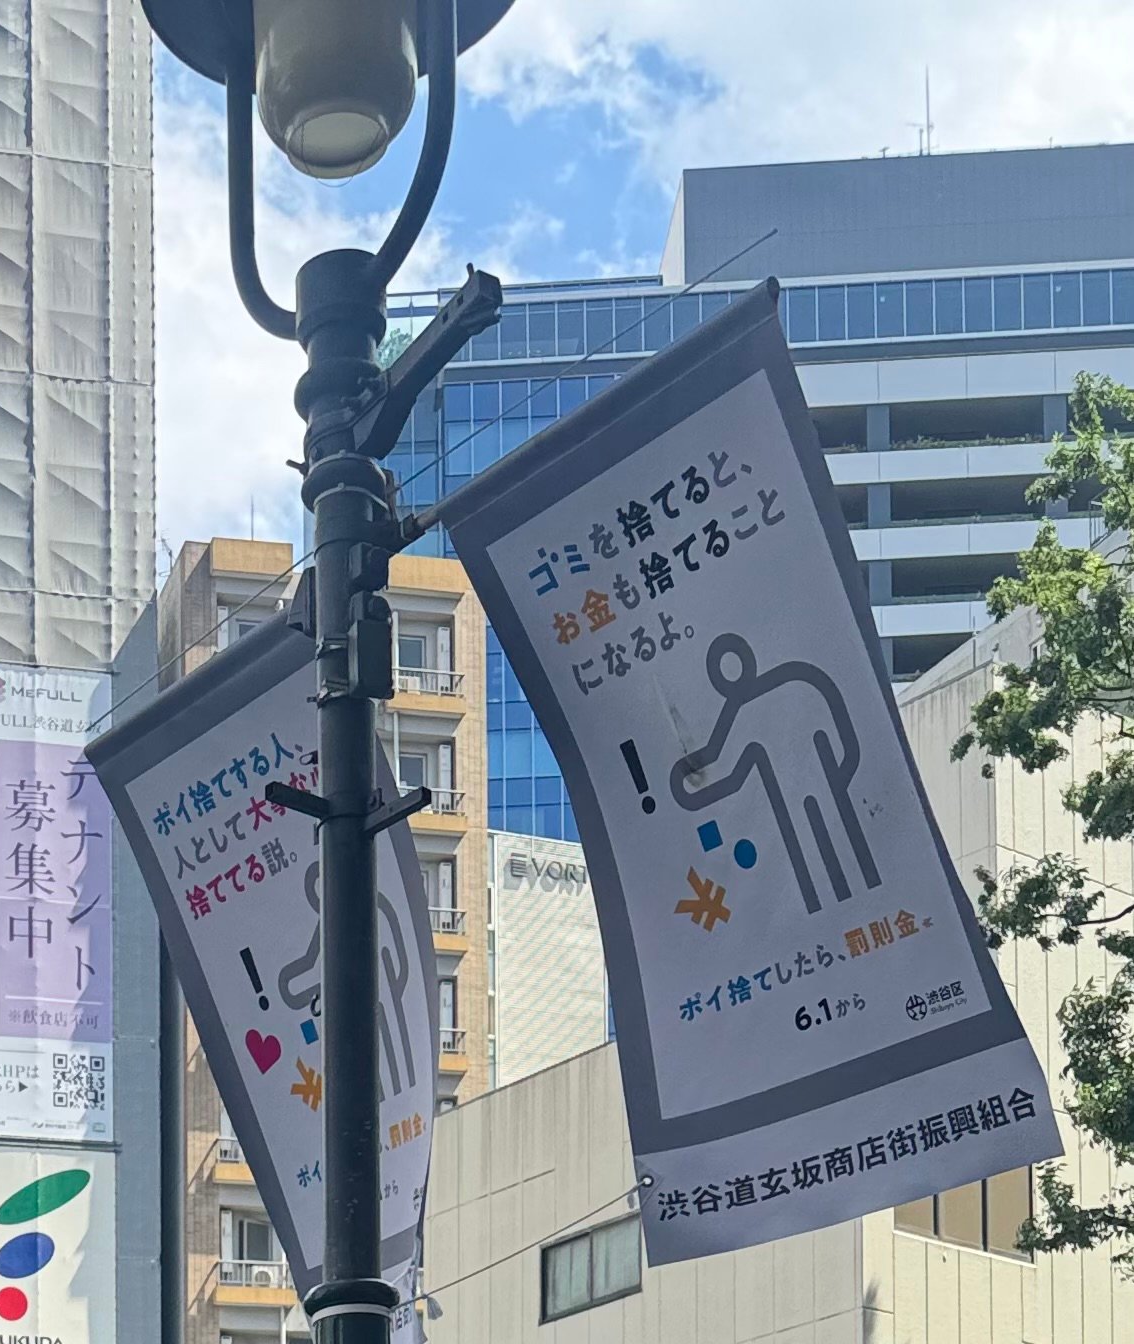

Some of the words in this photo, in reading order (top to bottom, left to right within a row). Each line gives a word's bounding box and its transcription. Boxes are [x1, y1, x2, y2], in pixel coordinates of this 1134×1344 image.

[529, 450, 753, 596] ゴミを捨てると、
[552, 488, 786, 646] お金も捨てること
[571, 612, 696, 697] になるよ。
[153, 732, 303, 836] ポイ捨てする人、
[4, 779, 56, 959] 募集中
[60, 759, 103, 991] テナント
[185, 837, 298, 921] 捨ててる説。
[794, 992, 866, 1031] 6.1から
[657, 1086, 1037, 1222] 渋谷道玄坂商店街振興組合
